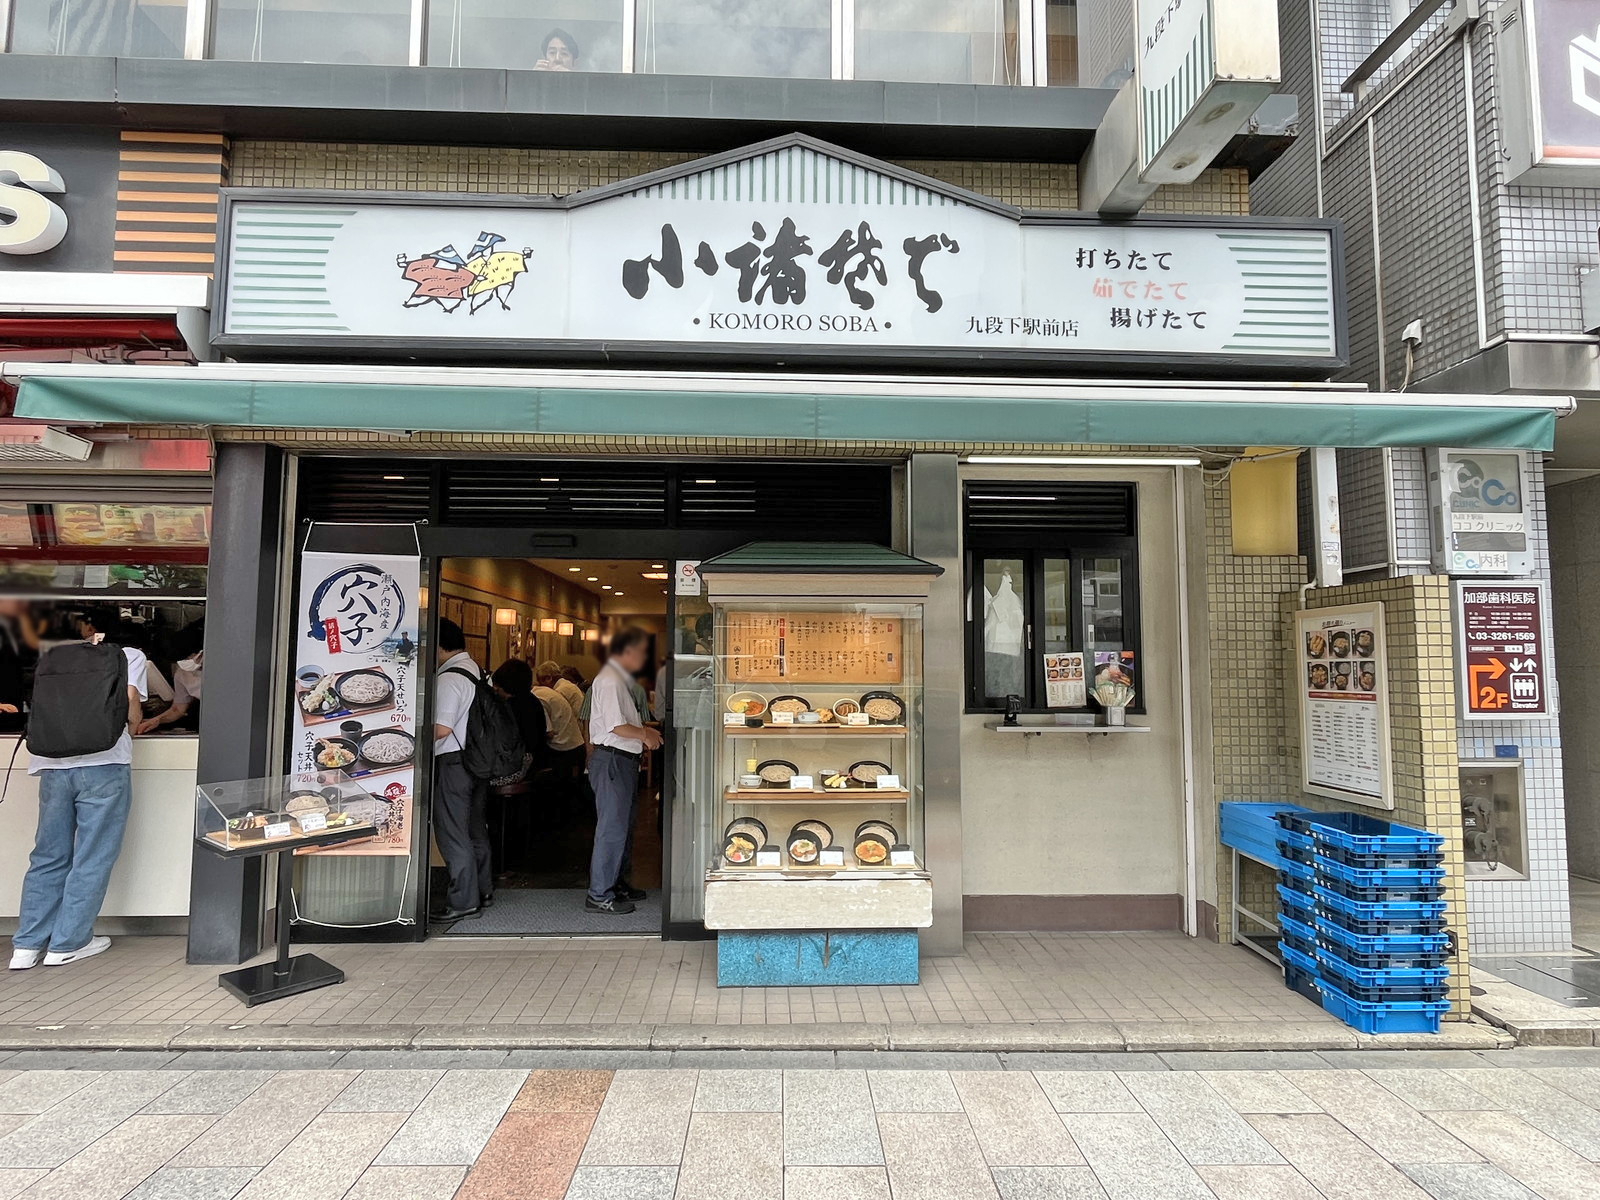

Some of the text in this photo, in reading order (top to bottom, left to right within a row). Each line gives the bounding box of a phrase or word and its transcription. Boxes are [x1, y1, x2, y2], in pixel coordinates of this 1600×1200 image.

[1076, 247, 1173, 271] 打ちたて
[1092, 276, 1188, 301] 茹でたて
[709, 312, 879, 332] KOMORO SOBA
[965, 316, 1080, 337] 九段下駅前店
[1110, 307, 1207, 330] 揚げたて
[1481, 554, 1507, 567] 内科
[1464, 592, 1536, 604] 加部歯科医院
[337, 574, 378, 647] 穴子
[1476, 632, 1536, 640] 03-3261-1569
[1480, 686, 1509, 709] 2F
